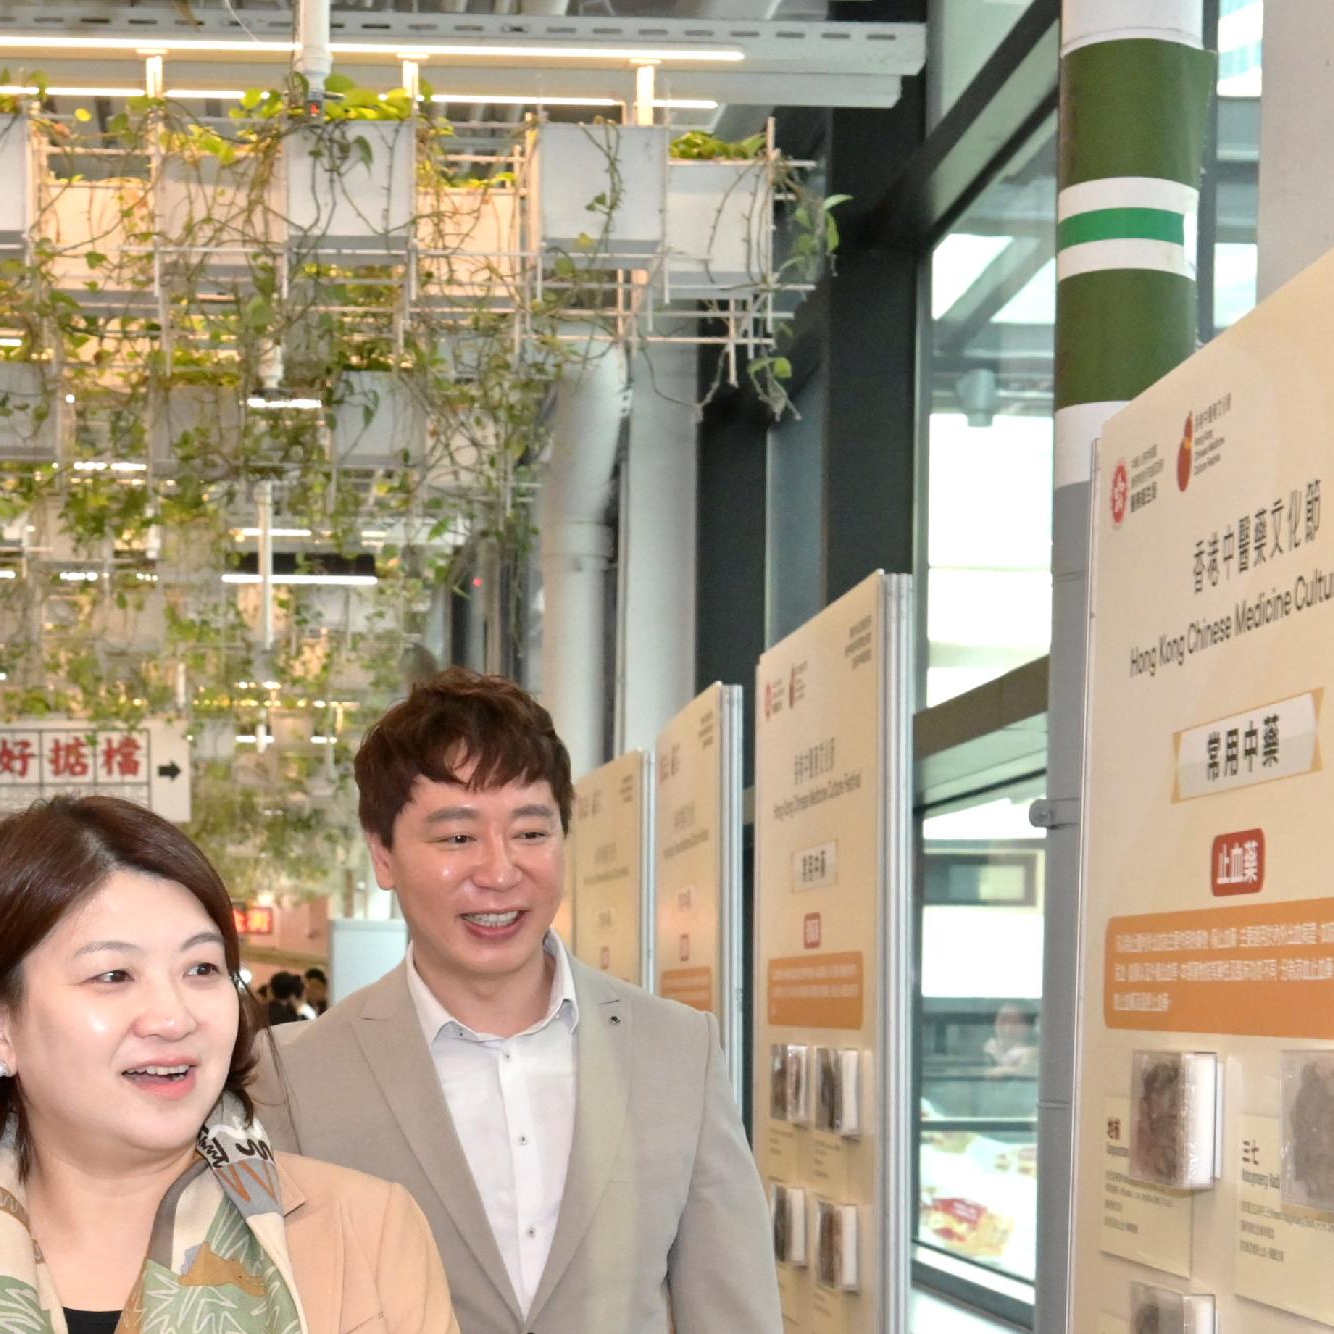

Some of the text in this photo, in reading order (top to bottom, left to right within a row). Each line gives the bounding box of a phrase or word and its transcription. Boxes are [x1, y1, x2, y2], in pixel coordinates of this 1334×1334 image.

[1193, 479, 1321, 595] 香港中醫藥文化節
[1130, 647, 1156, 677] Hong
[1159, 633, 1185, 666] Kong
[1187, 617, 1231, 654] Chinese
[1234, 588, 1292, 637] Medicine
[1207, 711, 1280, 782] 常用中藥
[1217, 838, 1259, 884] 止血藥
